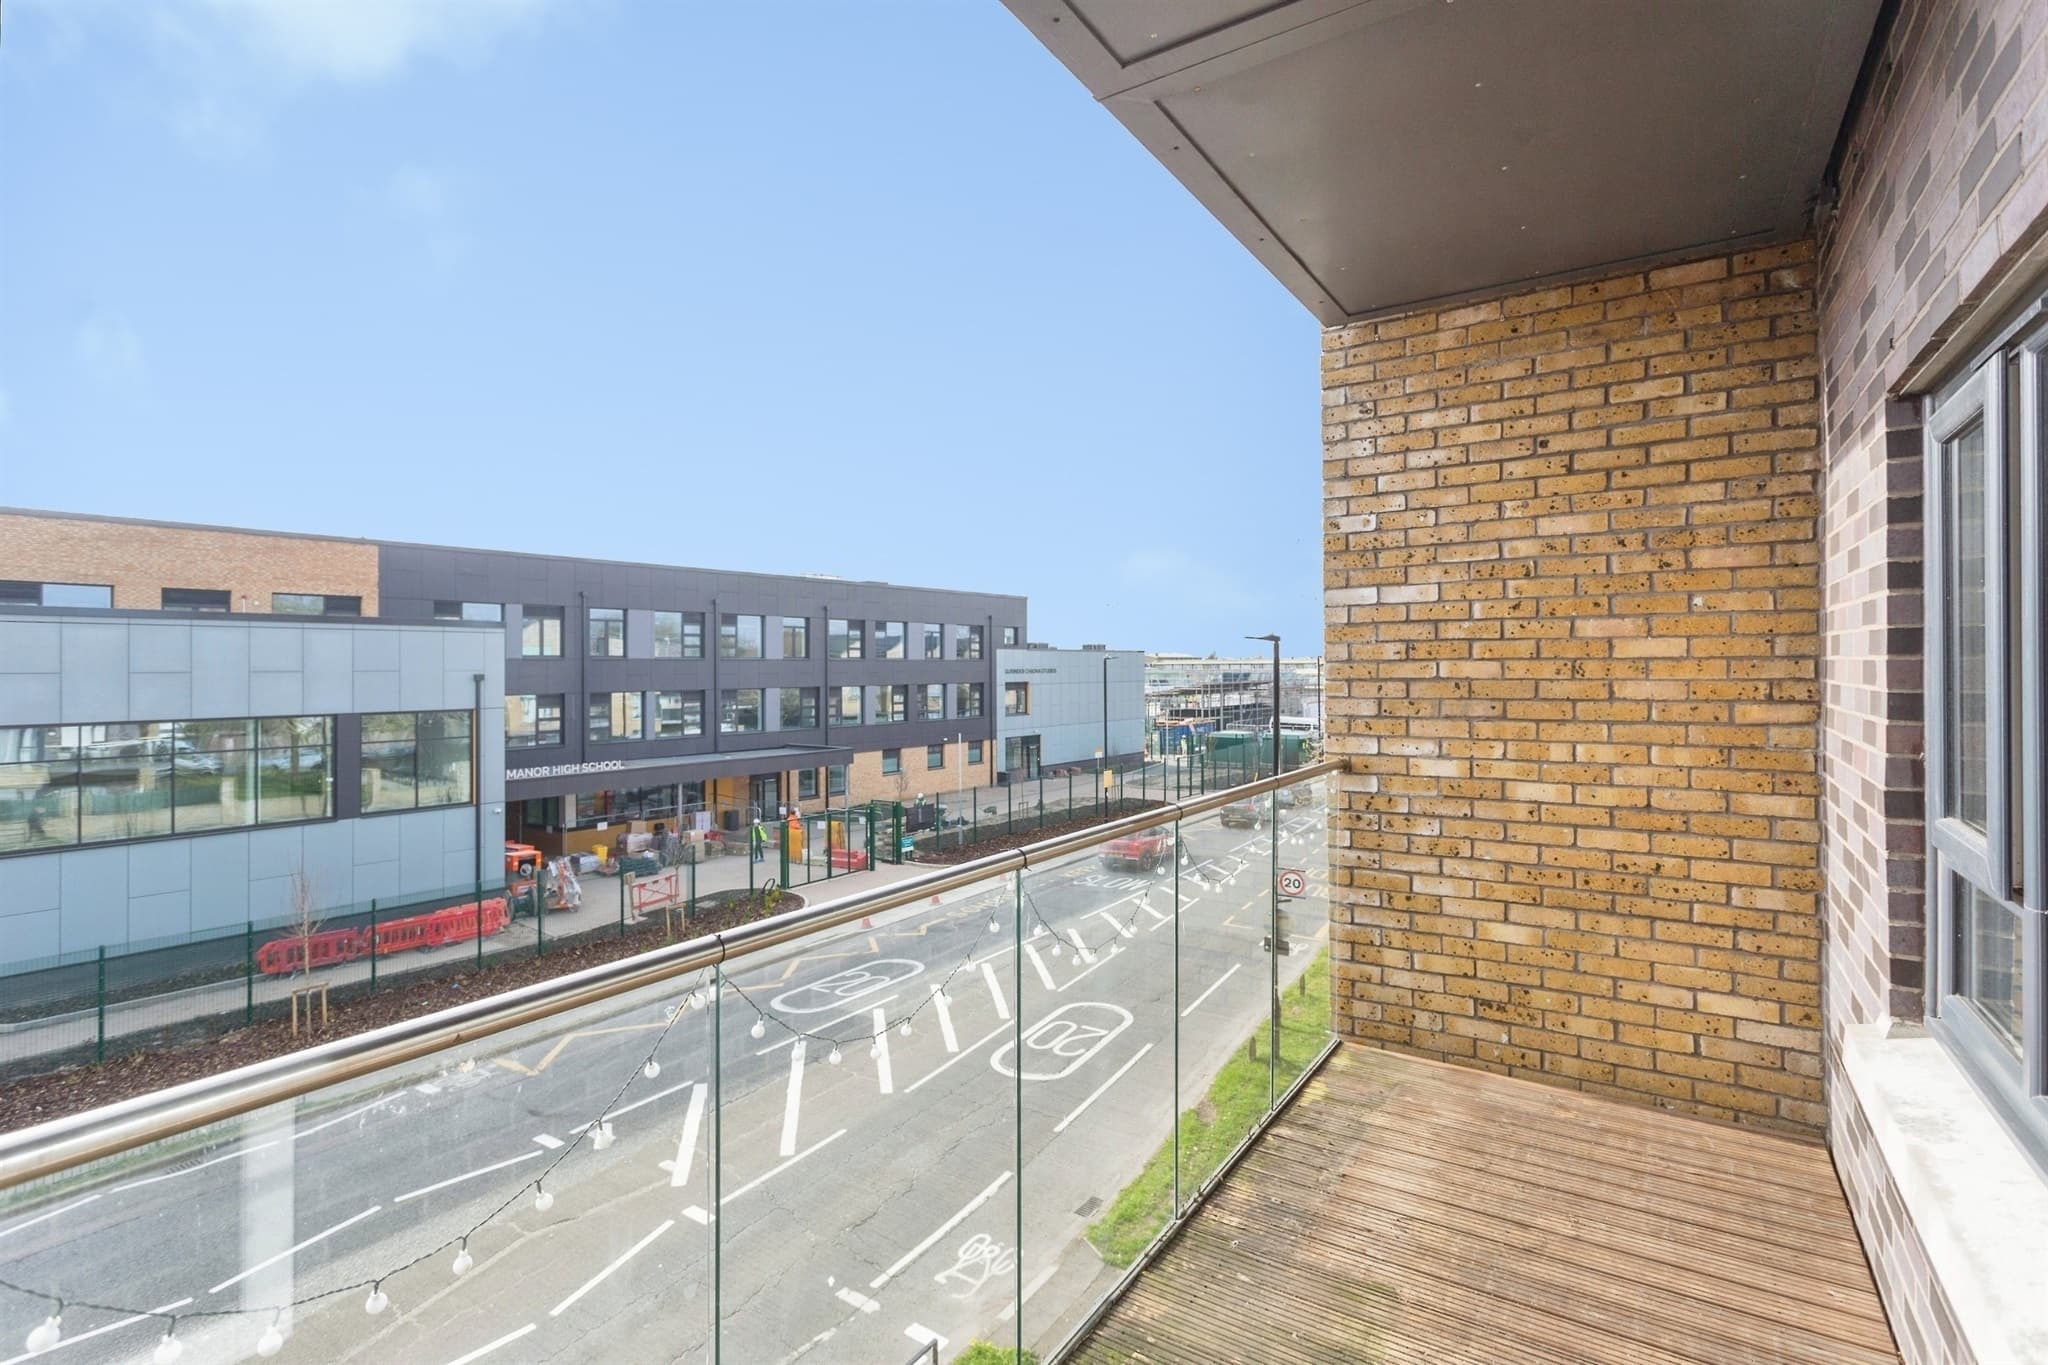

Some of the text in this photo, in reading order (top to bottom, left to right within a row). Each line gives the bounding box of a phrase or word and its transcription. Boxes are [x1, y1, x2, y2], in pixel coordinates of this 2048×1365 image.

[506, 759, 625, 780] MANOR HIGH SCHOOL
[1283, 877, 1301, 889] 20
[809, 970, 890, 997] 20
[1026, 1020, 1110, 1057] 20
